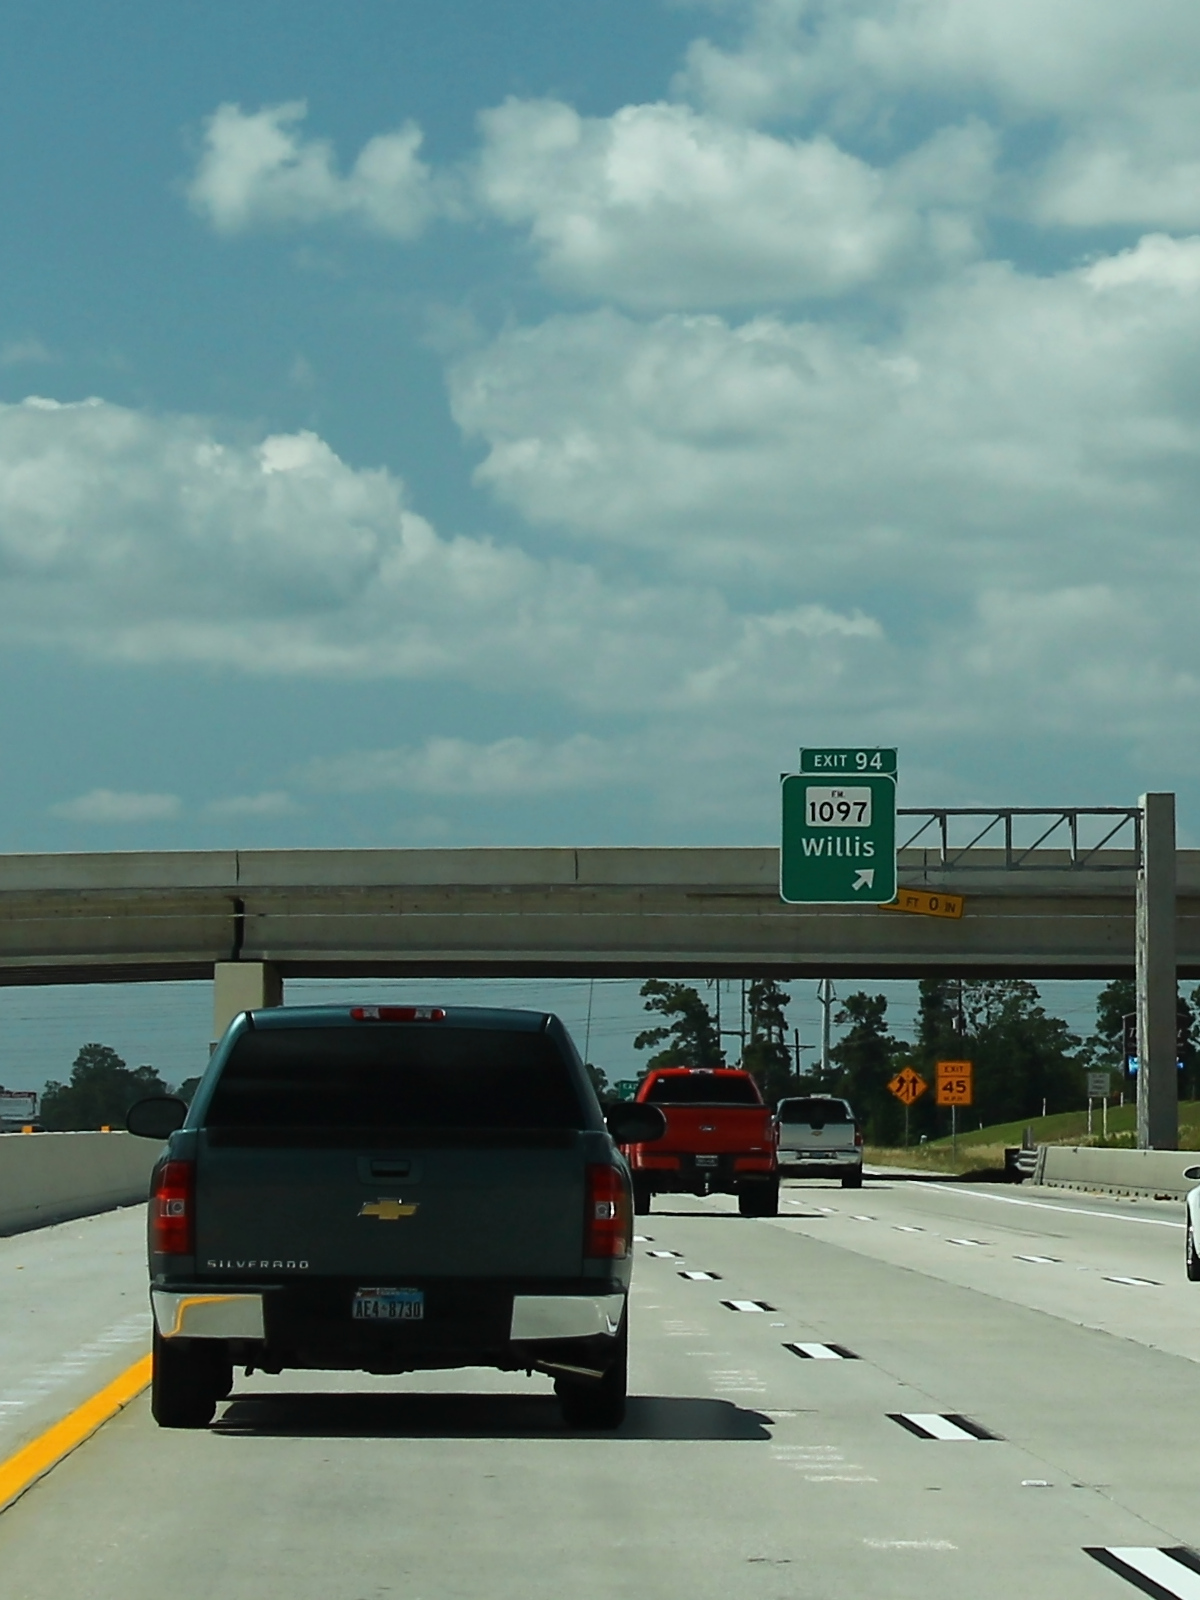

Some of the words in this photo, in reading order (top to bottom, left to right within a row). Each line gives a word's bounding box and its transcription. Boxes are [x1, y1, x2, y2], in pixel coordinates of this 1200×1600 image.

[814, 754, 847, 767] EXIT
[855, 752, 883, 770] 94
[809, 801, 867, 822] 1097
[801, 836, 875, 857] Willis
[906, 897, 919, 907] FT
[929, 896, 939, 911] 0
[944, 903, 956, 913] IN
[942, 1080, 967, 1094] 45
[207, 1259, 310, 1269] SILVERADO
